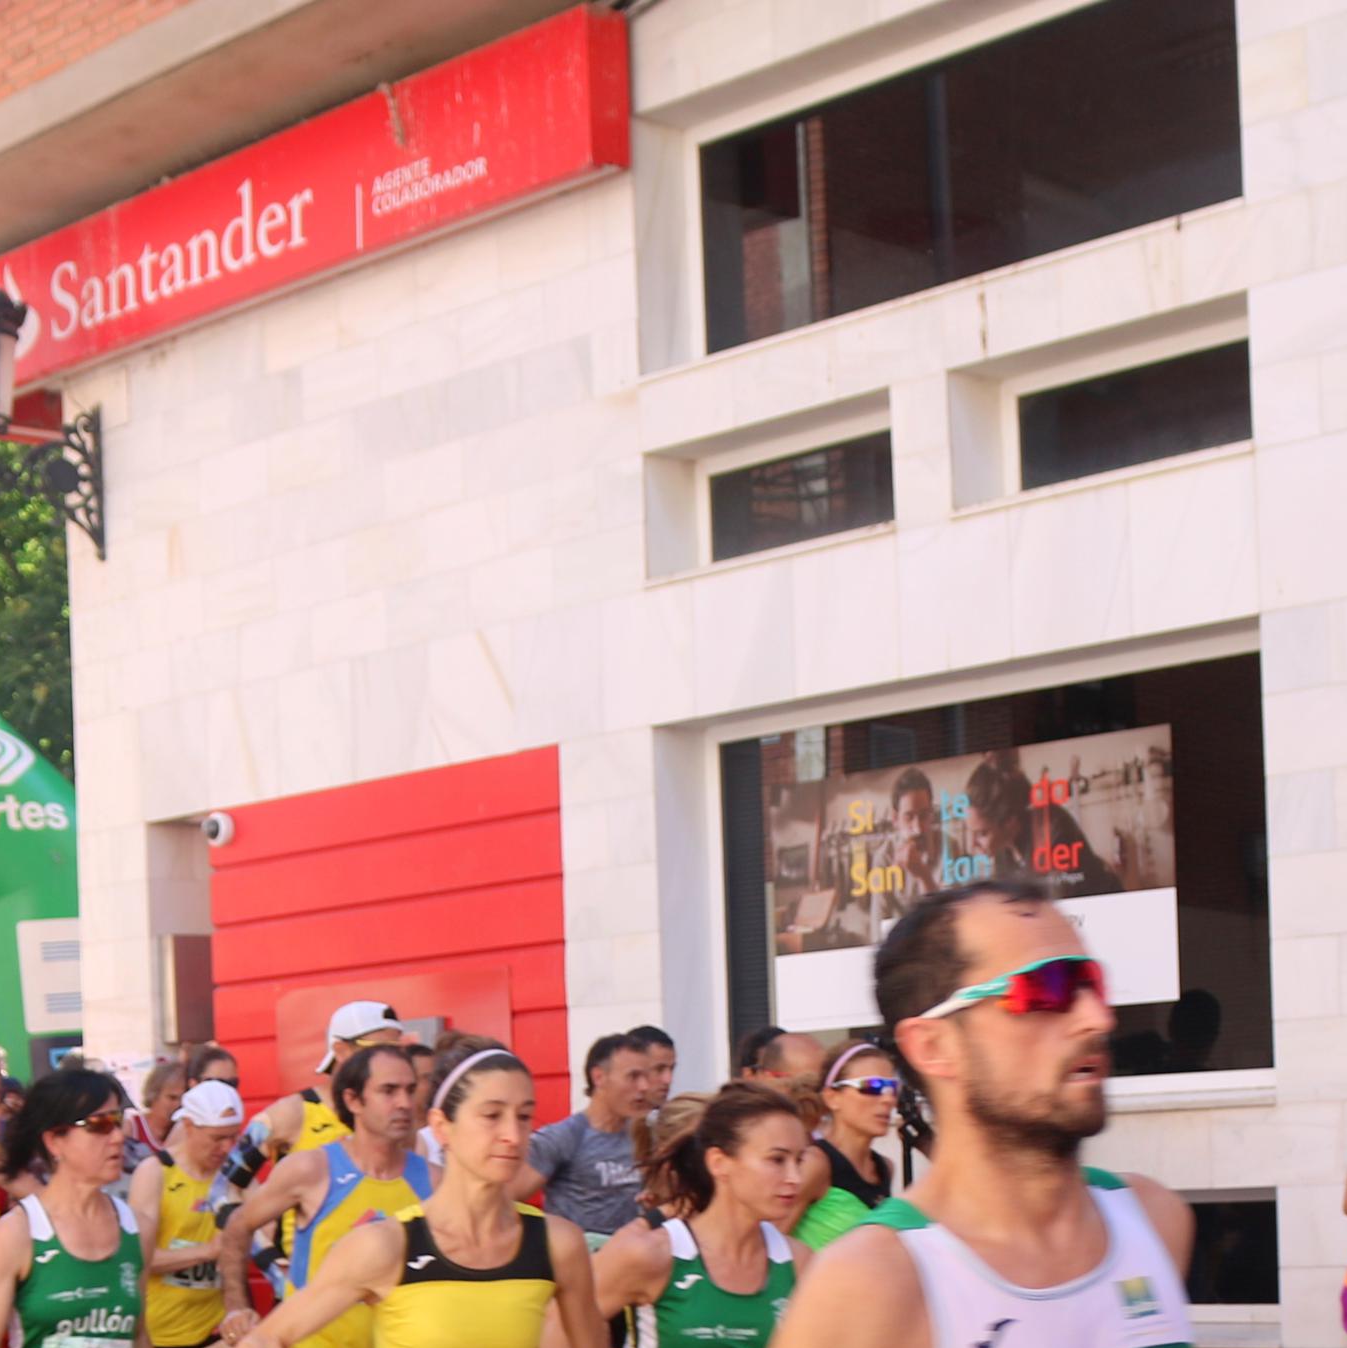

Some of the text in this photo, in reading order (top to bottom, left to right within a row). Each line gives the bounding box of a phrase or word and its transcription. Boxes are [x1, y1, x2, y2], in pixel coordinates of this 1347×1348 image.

[372, 157, 429, 196] AGENTE
[372, 156, 488, 216] COLABORADOR
[51, 178, 314, 341] Santander
[848, 774, 1071, 834] Si te da
[851, 839, 1084, 896] San tan der
